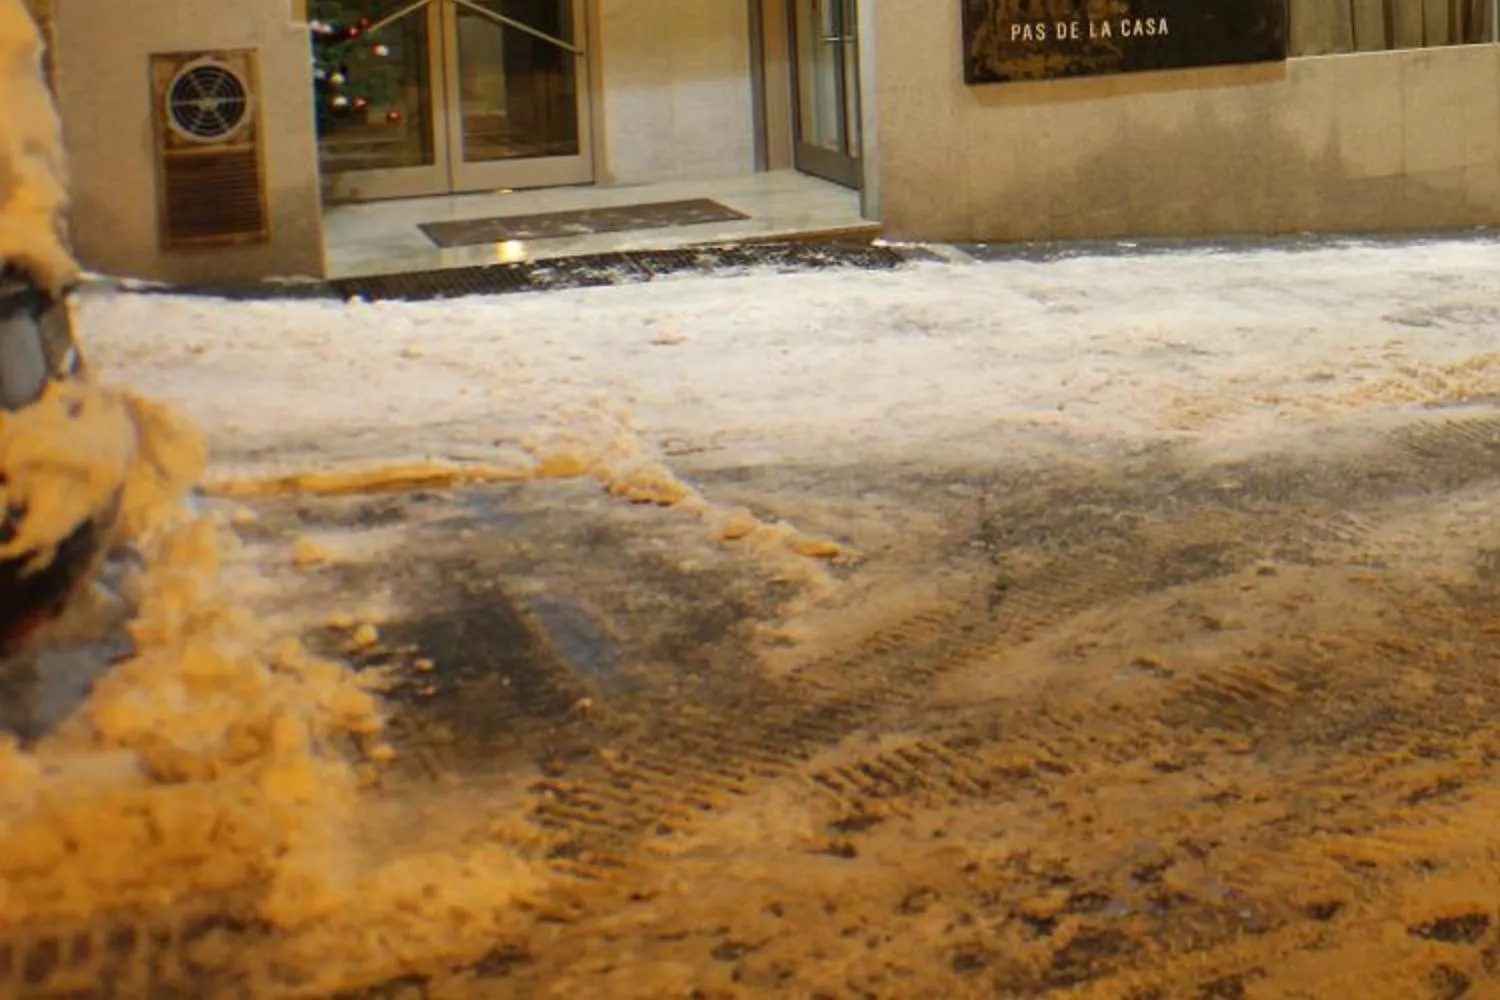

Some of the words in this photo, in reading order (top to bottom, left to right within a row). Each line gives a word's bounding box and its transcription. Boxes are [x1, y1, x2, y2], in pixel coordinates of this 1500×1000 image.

[1011, 23, 1046, 41] PAS
[1056, 21, 1079, 40] DE
[1089, 20, 1112, 39] LA
[1121, 17, 1169, 37] CASA
